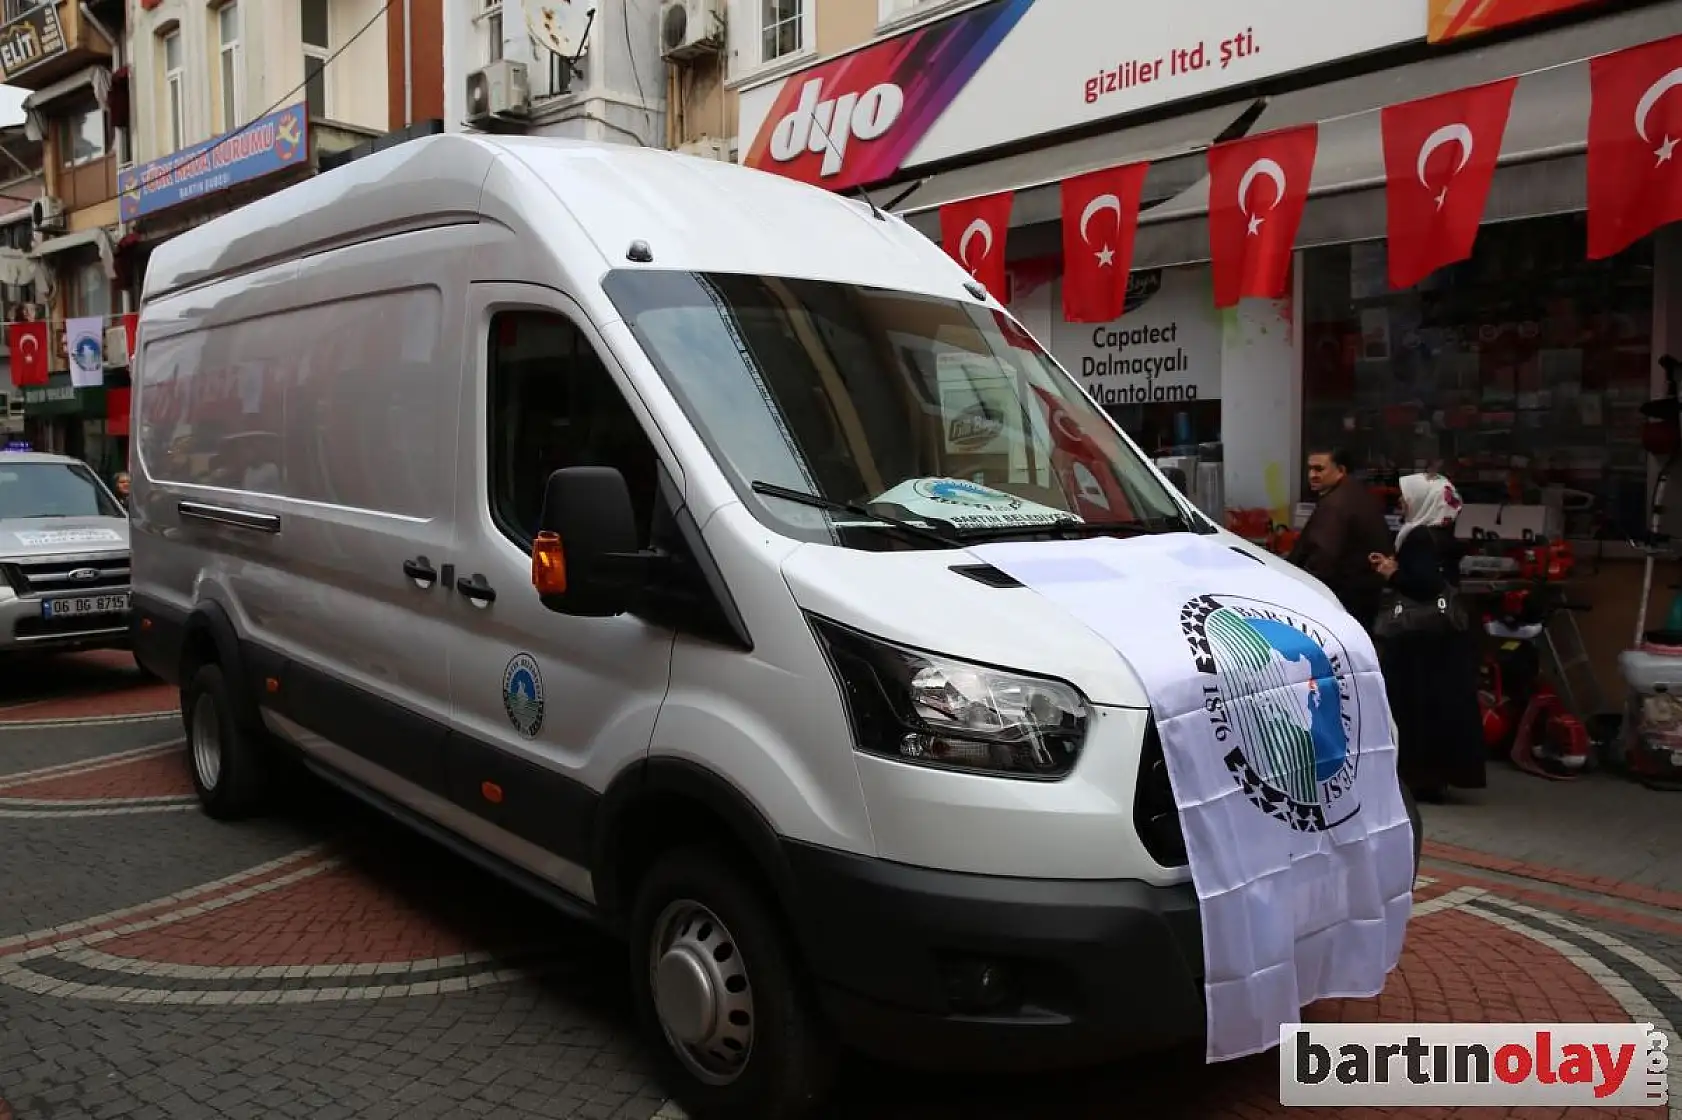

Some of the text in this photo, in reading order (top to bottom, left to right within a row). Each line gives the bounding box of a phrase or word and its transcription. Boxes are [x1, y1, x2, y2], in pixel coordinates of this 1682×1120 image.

[1085, 26, 1260, 104] gizliler ltd. şti.
[770, 77, 904, 177] dyo
[1092, 321, 1178, 352] Capatect
[1082, 347, 1189, 380] Dalmaçyalı
[1087, 379, 1198, 404] Mantolama
[54, 600, 69, 613] 06
[1202, 684, 1232, 742] 1876
